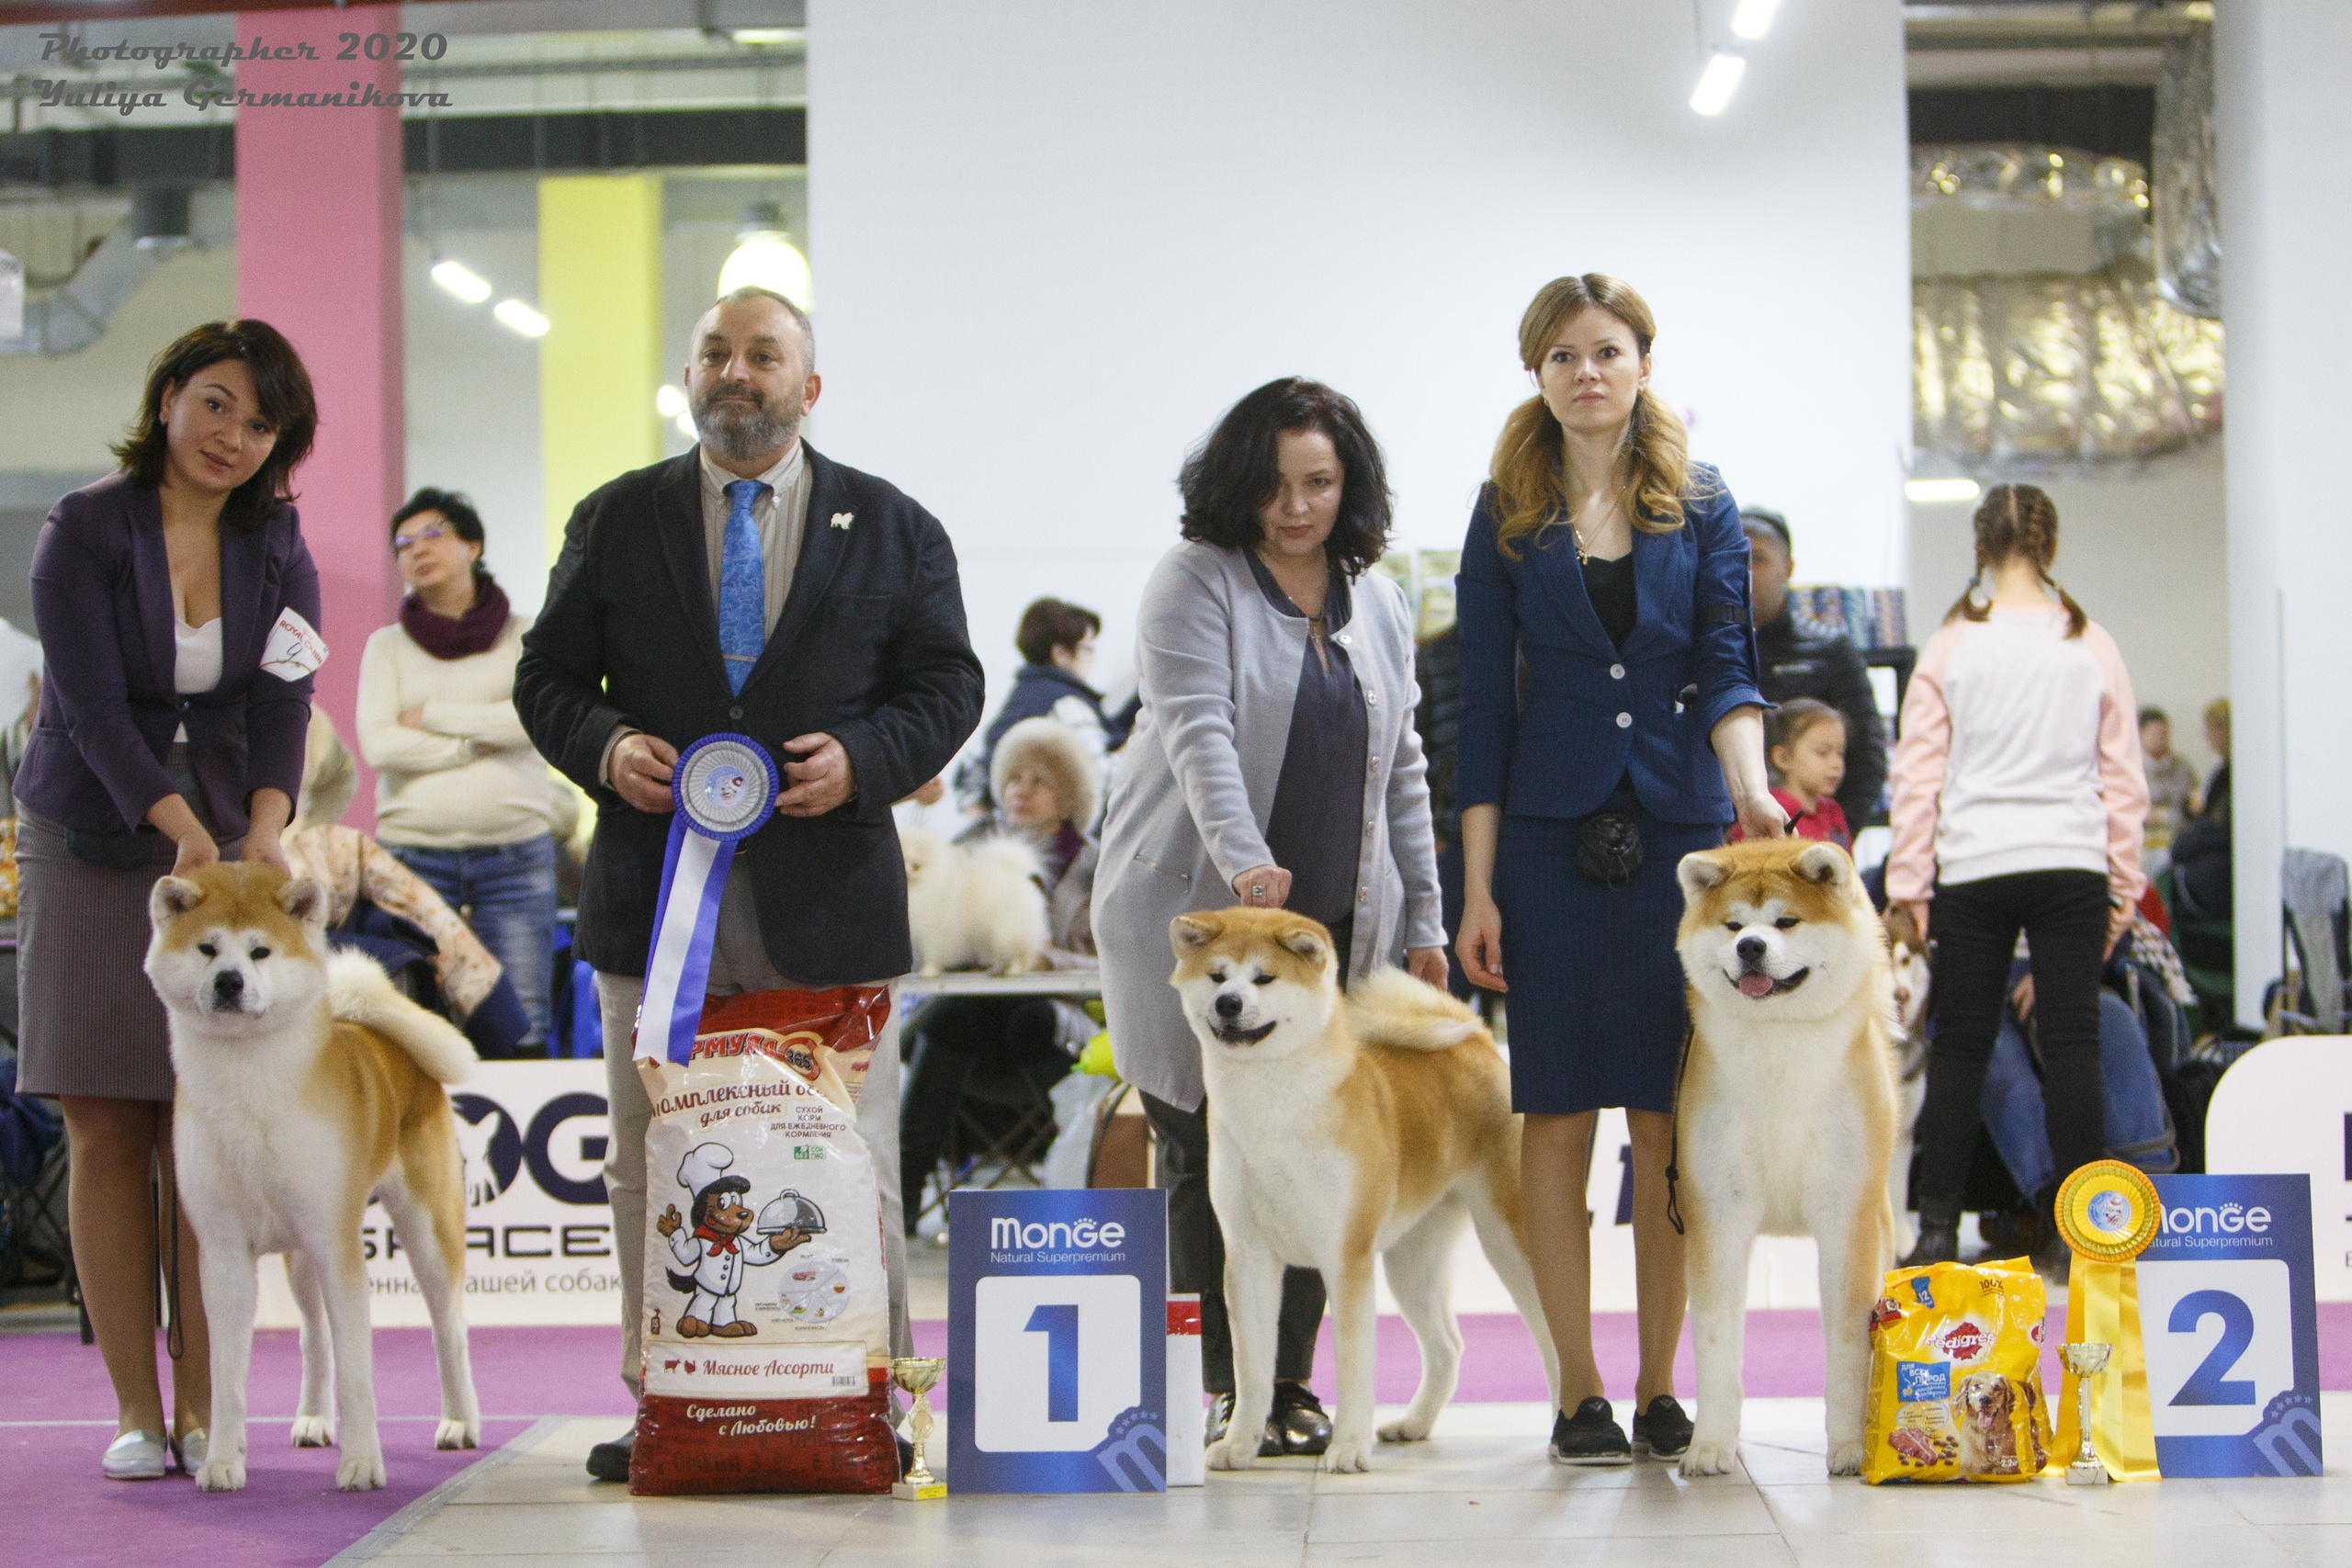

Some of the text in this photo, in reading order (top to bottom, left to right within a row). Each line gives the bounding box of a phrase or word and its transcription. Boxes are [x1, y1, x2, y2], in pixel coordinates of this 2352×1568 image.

[279, 620, 304, 642] ROYAL
[650, 1032, 814, 1070] РМУЛА 365
[700, 1100, 782, 1128] для собак
[796, 1105, 823, 1114] СУХОЙ
[770, 1122, 847, 1132] ДЛЯ ЕЖЕДНЕВНОГО
[2149, 1235, 2273, 1250] atural Superpremium
[990, 1251, 1125, 1265] Natural Superpremium
[465, 1269, 537, 1293] ашей
[2167, 1289, 2256, 1405] 2
[702, 1359, 834, 1379] Мясное Ассорти
[1023, 1304, 1079, 1423] 1
[686, 1404, 756, 1421] Сделано
[718, 1415, 817, 1437] с Любовью!
